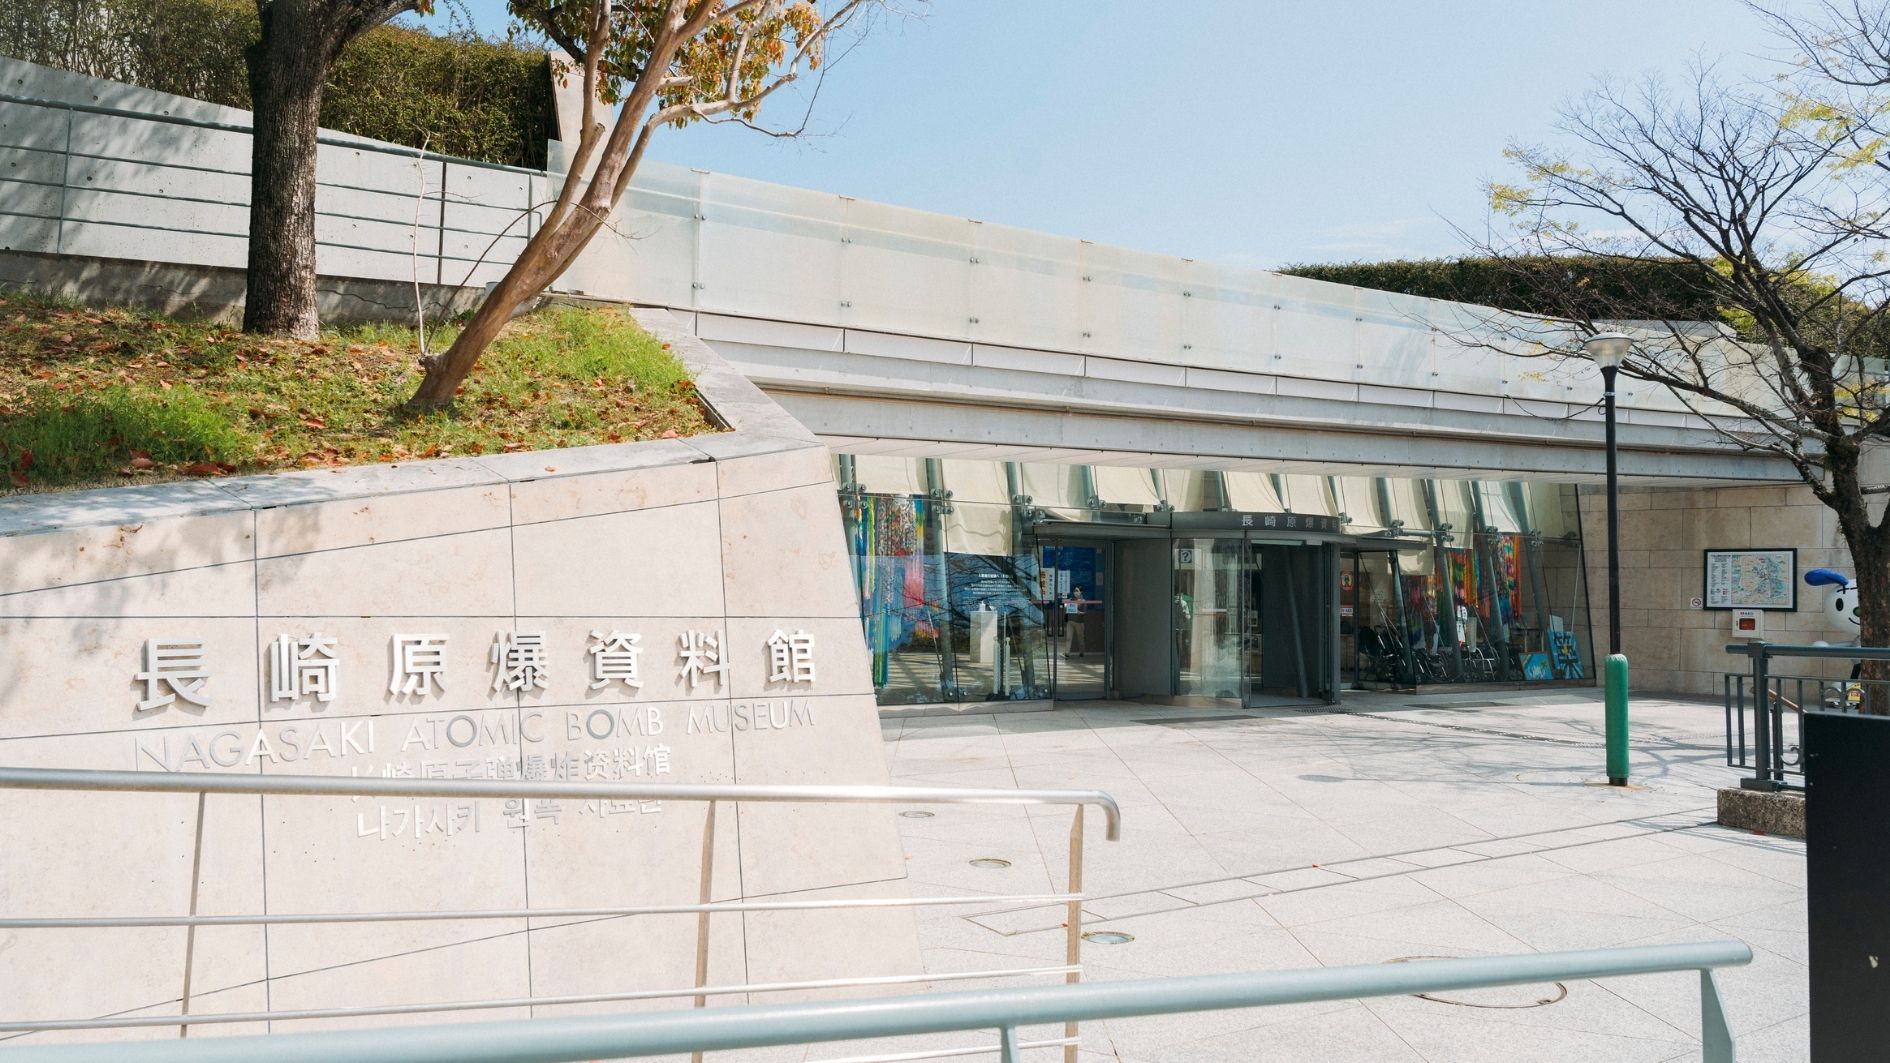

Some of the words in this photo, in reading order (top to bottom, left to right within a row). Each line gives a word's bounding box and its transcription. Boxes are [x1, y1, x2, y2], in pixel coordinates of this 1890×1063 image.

[135, 628, 817, 712] 長崎原爆資料館
[135, 719, 375, 773] NAGASAKI
[401, 712, 545, 752] ATOMIC
[566, 706, 664, 745] BOMB
[686, 698, 816, 735] MUSEUM
[356, 799, 481, 841] 나가사키
